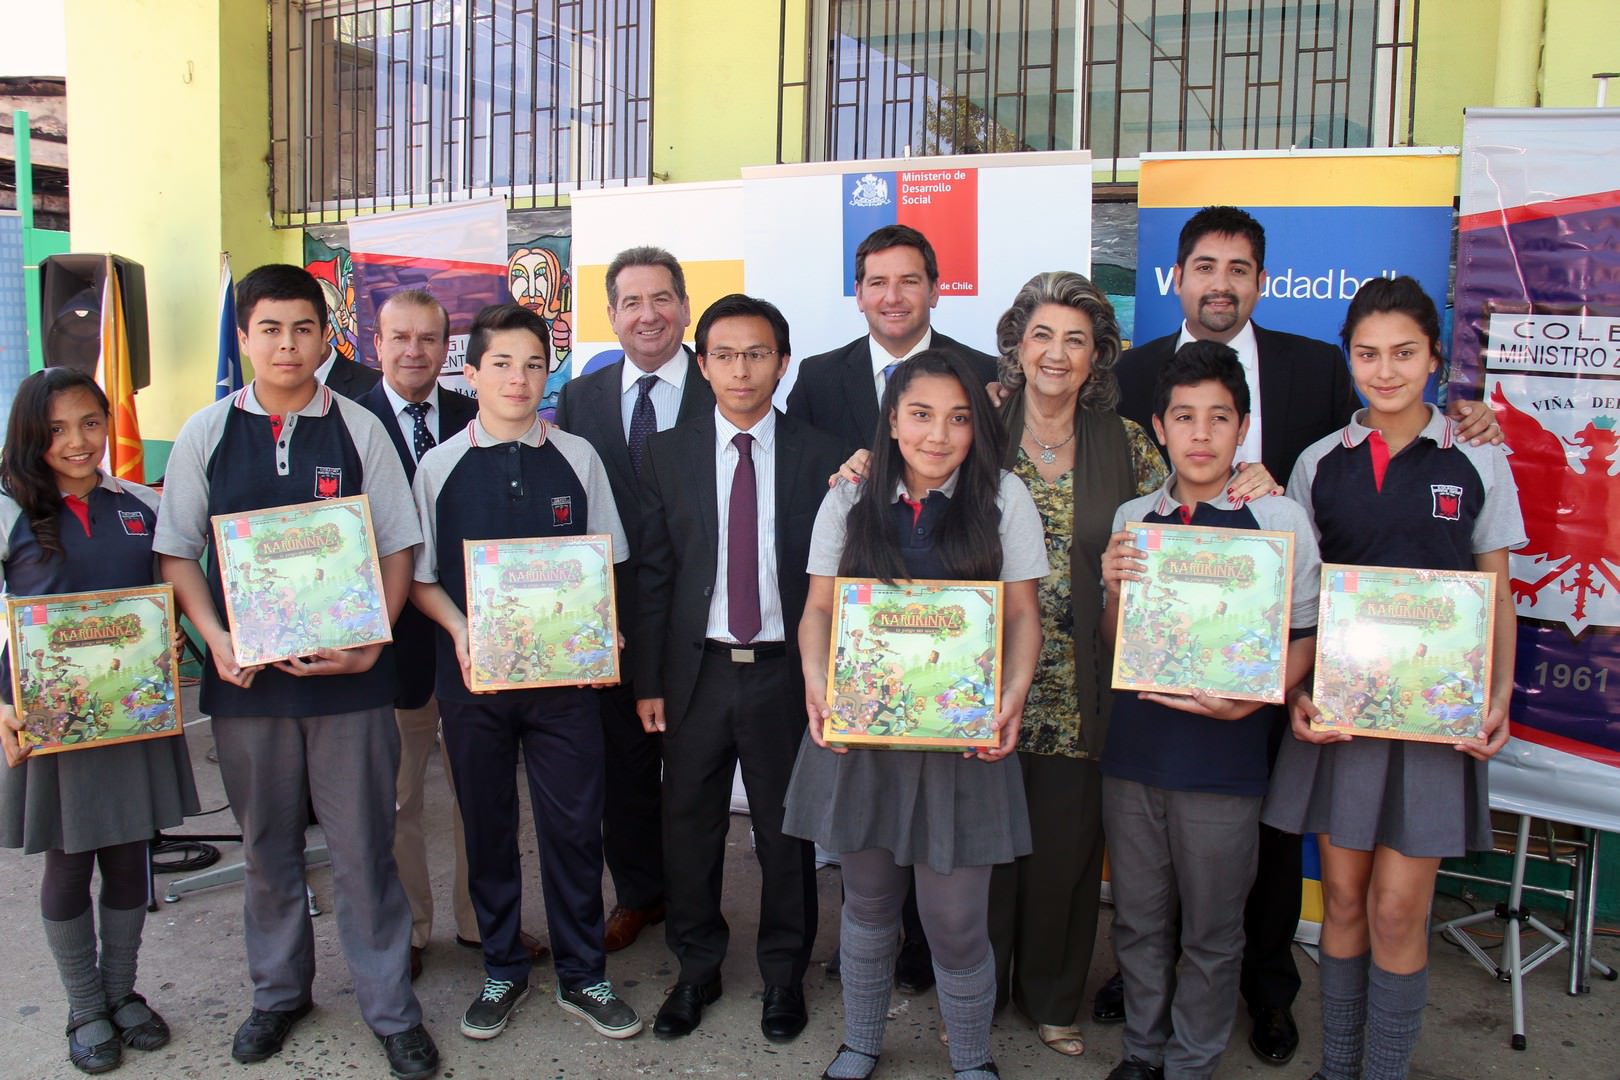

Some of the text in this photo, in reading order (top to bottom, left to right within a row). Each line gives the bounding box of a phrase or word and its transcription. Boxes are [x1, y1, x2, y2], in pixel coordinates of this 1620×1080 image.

[902, 170, 966, 182] Ministerio de
[902, 183, 951, 193] Desarrollo
[902, 194, 932, 205] Social
[940, 282, 973, 290] de Chile
[1499, 343, 1607, 368] MINISTRO
[1532, 396, 1575, 412] VIÑA
[1535, 661, 1609, 693] 1961
